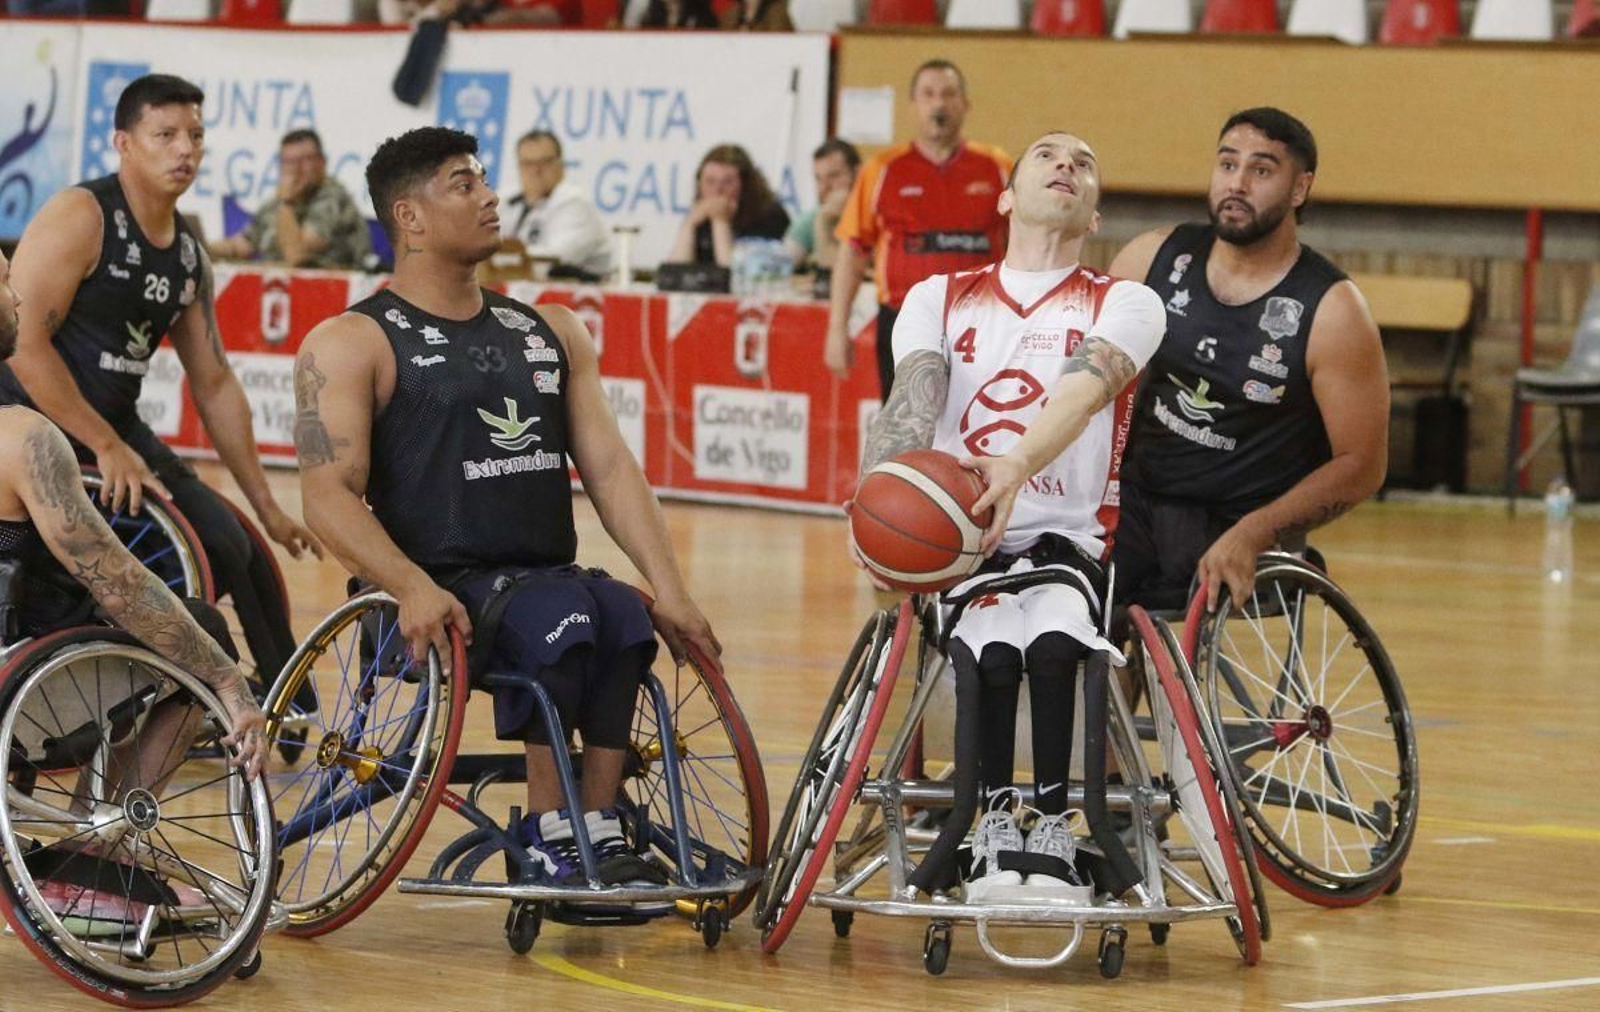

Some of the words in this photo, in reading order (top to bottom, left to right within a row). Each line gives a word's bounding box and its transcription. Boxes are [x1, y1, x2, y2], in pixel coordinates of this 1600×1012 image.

[199, 79, 317, 130] UNTA
[533, 86, 695, 139] XUNTA
[593, 160, 799, 215] GALA
[144, 273, 171, 303] 26
[468, 345, 507, 373] 33
[954, 327, 977, 363] 4
[700, 395, 803, 430] Concello
[462, 449, 561, 480] Extremadura
[706, 441, 733, 467] de
[741, 437, 791, 482] Vigo
[1023, 474, 1066, 497] NSA
